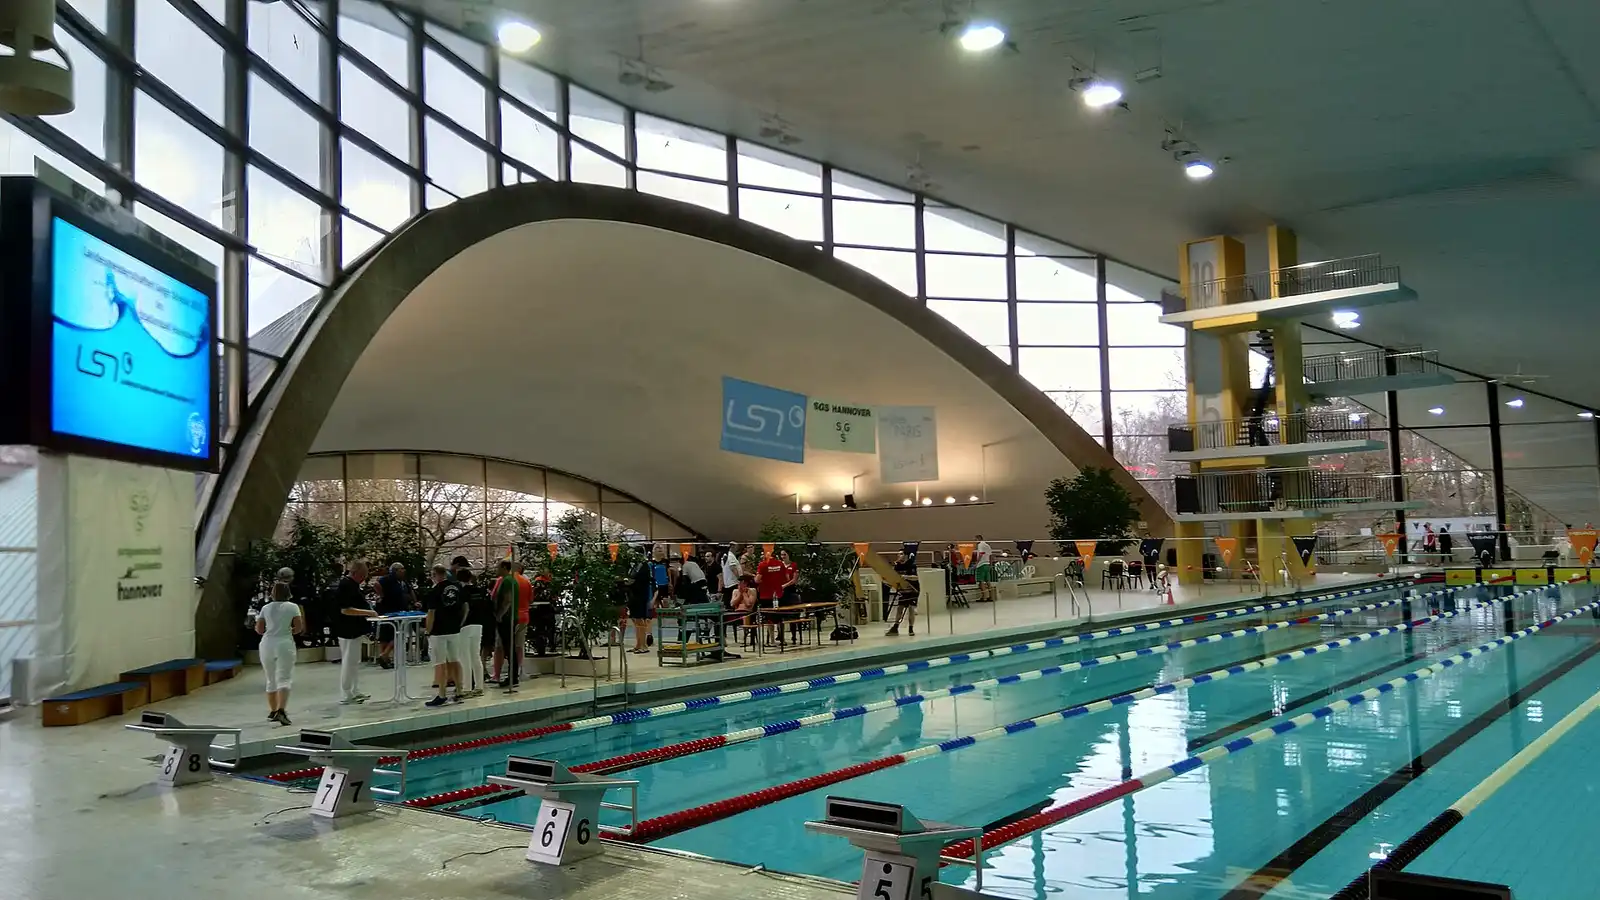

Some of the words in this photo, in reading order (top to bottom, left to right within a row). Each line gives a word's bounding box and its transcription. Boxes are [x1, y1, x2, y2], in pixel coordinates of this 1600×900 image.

[813, 402, 829, 412] SGS
[832, 405, 871, 417] HANNOVER
[840, 433, 846, 442] S
[164, 757, 174, 775] 8
[188, 754, 201, 773] 8
[320, 784, 333, 805] 7
[350, 781, 364, 803] 7
[541, 821, 555, 847] 6
[577, 819, 590, 845] 6
[875, 879, 892, 900] 5
